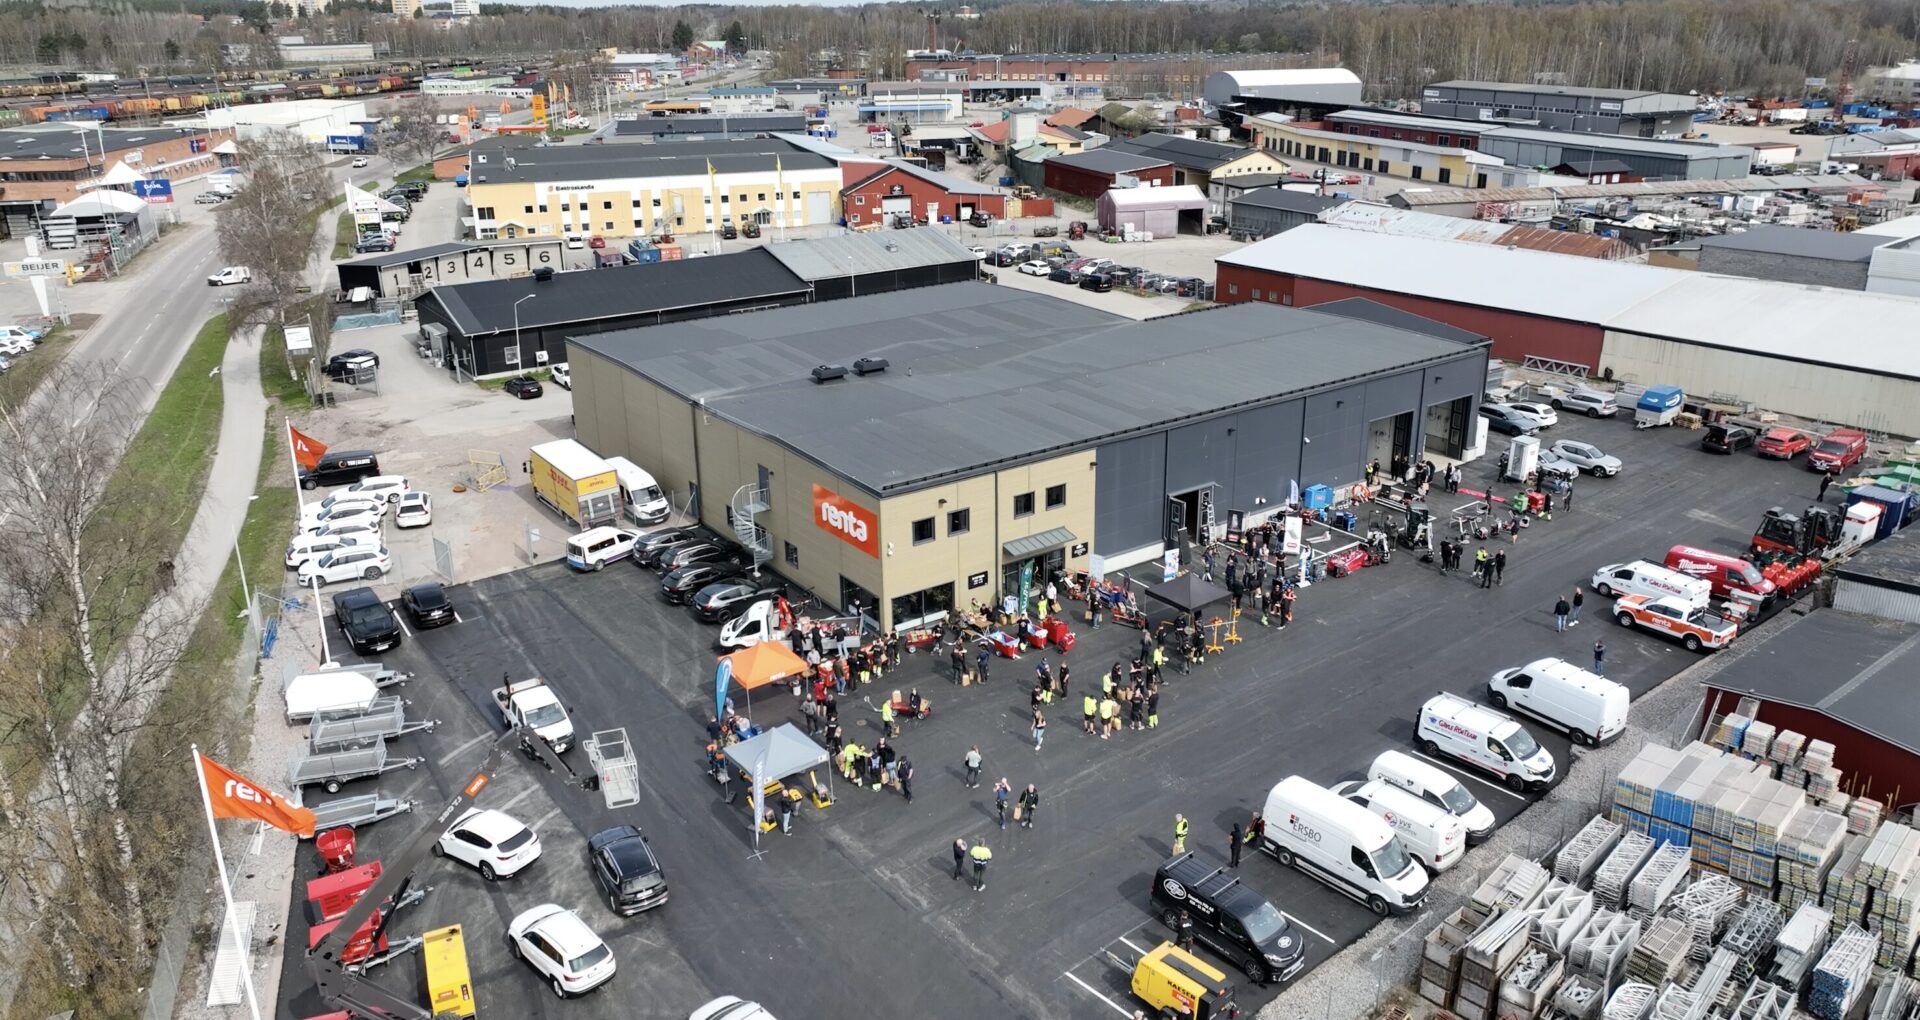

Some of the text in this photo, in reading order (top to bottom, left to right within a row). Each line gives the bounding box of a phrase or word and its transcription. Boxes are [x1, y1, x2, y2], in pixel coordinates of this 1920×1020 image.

[21, 262, 59, 272] BEIJER
[394, 251, 550, 286] 1 2 3 4 5 6
[821, 502, 868, 542] renta
[1651, 617, 1672, 628] renta
[1292, 822, 1322, 842] ERSBO
[1167, 980, 1196, 1000] KAESER
